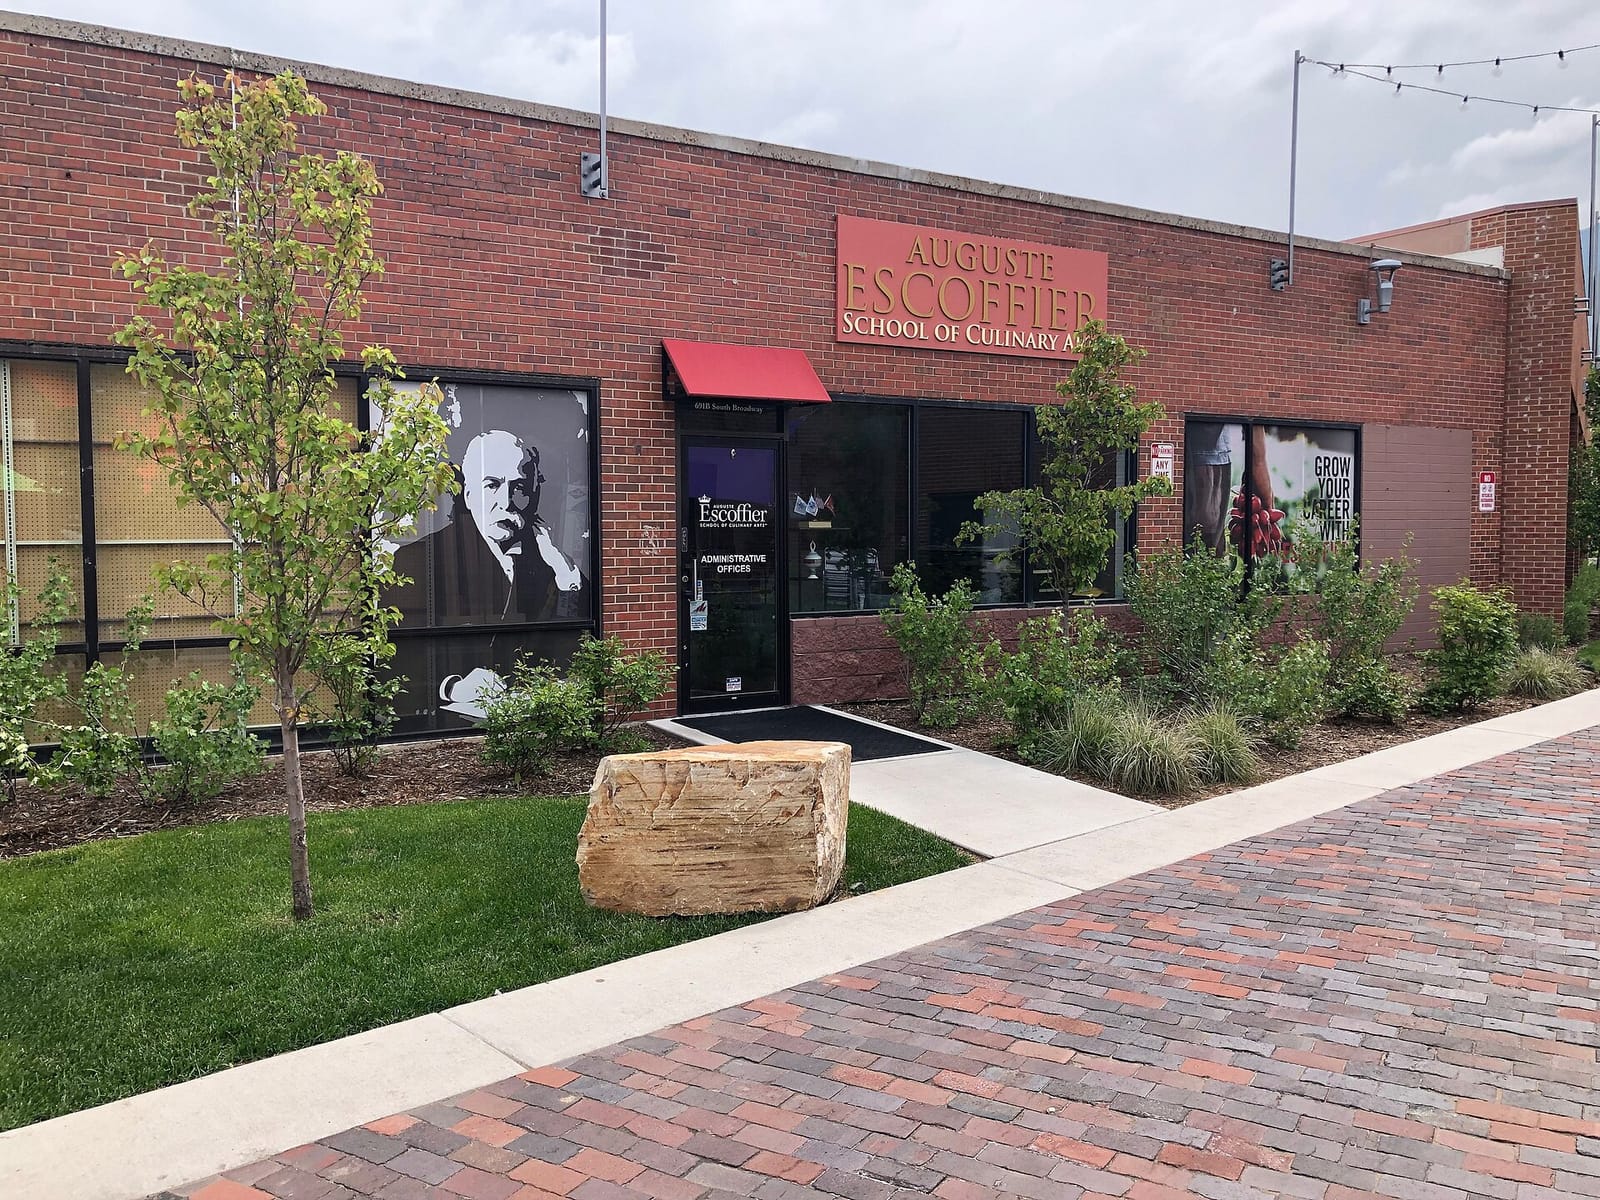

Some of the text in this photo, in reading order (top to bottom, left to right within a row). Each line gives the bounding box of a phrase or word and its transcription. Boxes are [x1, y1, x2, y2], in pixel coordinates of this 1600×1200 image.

[906, 234, 1054, 281] AUGUSTE
[843, 263, 1096, 331] ESCOFFIER
[842, 312, 929, 341] SCHOOL
[934, 323, 960, 343] OF
[965, 324, 1060, 352] CULINARY
[711, 403, 731, 411] South
[732, 404, 763, 414] Broadway
[1155, 460, 1168, 470] ANY
[1315, 456, 1351, 477] GROW
[1318, 478, 1350, 498] YOUR
[699, 503, 768, 522] Escoffier
[1320, 520, 1350, 541] WITH
[701, 554, 767, 563] ADMINISTRATIVE
[717, 564, 751, 573] OFFICES
